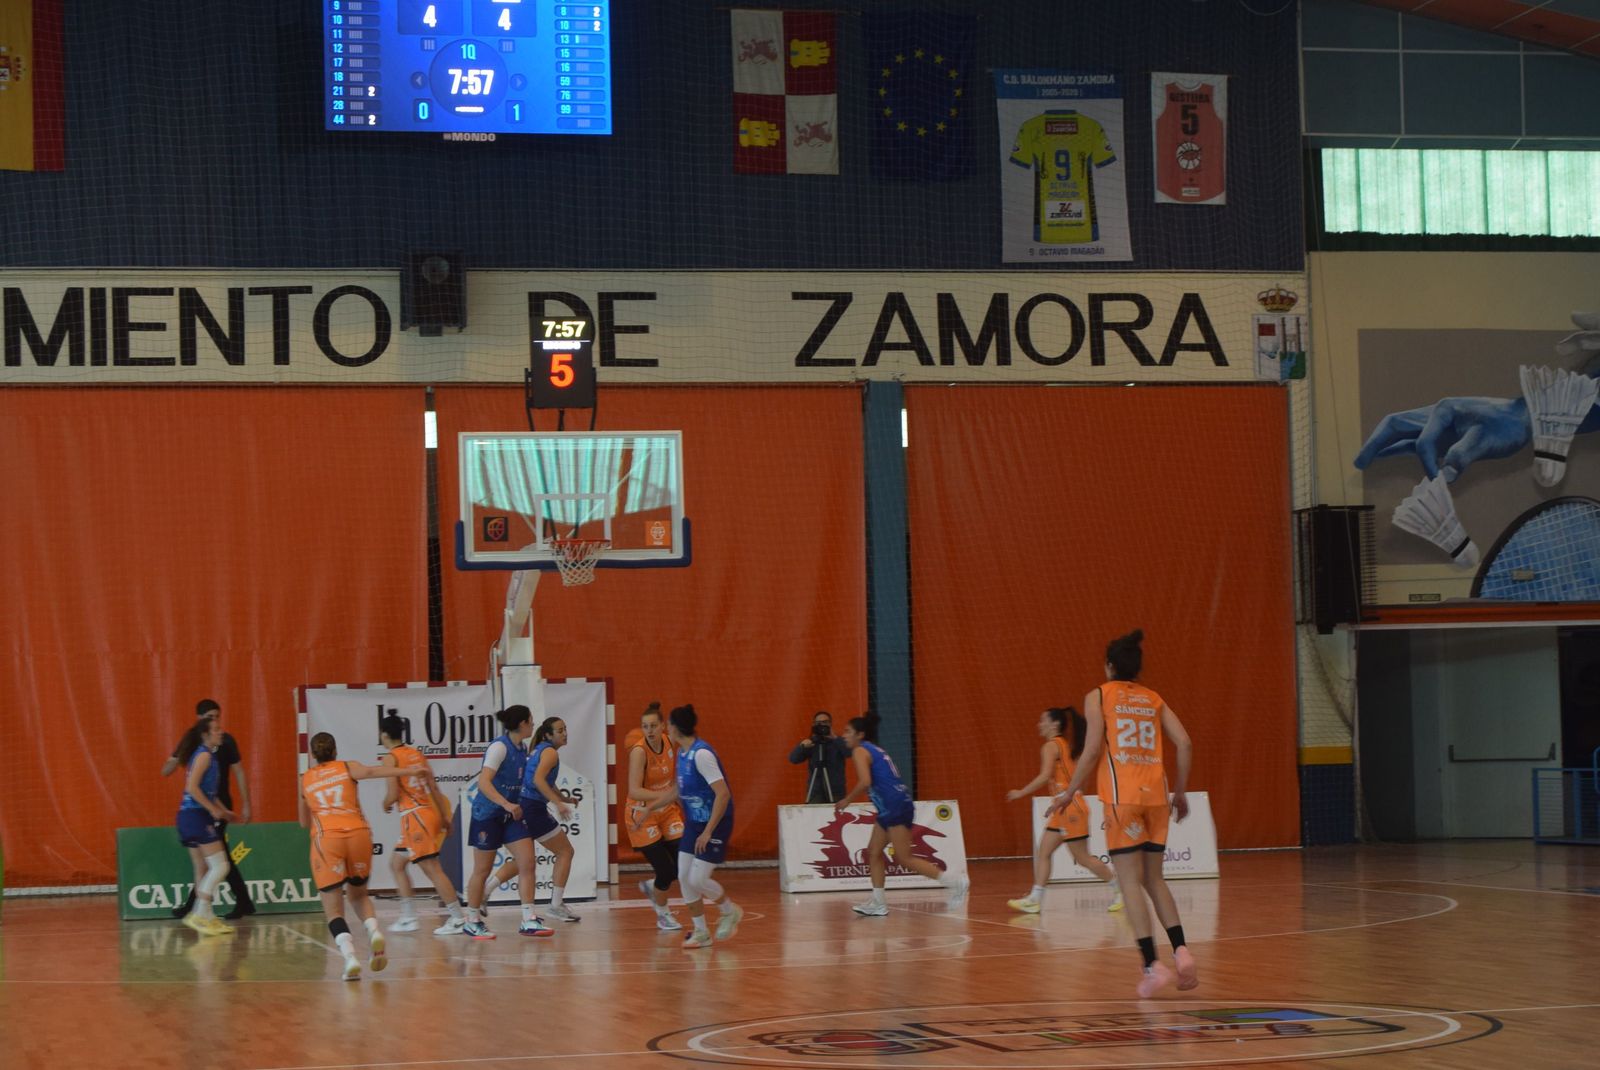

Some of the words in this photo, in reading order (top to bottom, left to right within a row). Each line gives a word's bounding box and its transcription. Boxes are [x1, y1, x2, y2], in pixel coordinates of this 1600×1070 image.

[332, 15, 343, 24] 10
[423, 5, 437, 28] 4
[498, 8, 512, 31] 4
[593, 6, 601, 17] 2
[593, 20, 601, 31] 2
[333, 29, 342, 39] 11
[333, 43, 343, 53] 12
[461, 44, 476, 60] 1Q
[333, 57, 343, 67] 17
[448, 68, 494, 95] 7:57
[1077, 74, 1115, 85] ZAMORA
[333, 86, 343, 96] 21
[367, 86, 376, 97] 2
[418, 102, 429, 120] 0
[513, 104, 520, 121] 1
[333, 114, 344, 124] 44
[368, 115, 376, 125] 2
[1181, 104, 1200, 136] 5
[452, 133, 496, 142] MONDO
[1055, 149, 1071, 181] 9
[3, 284, 392, 367] MIENTO
[528, 292, 659, 367] DE
[791, 291, 1229, 367] ZAMORA
[542, 320, 586, 338] 7:57
[550, 353, 575, 388] 5
[1116, 718, 1156, 751] 28
[315, 784, 345, 808] 17
[1162, 847, 1191, 862] alud
[826, 865, 889, 877] TERNE
[129, 882, 196, 909] CAJ
